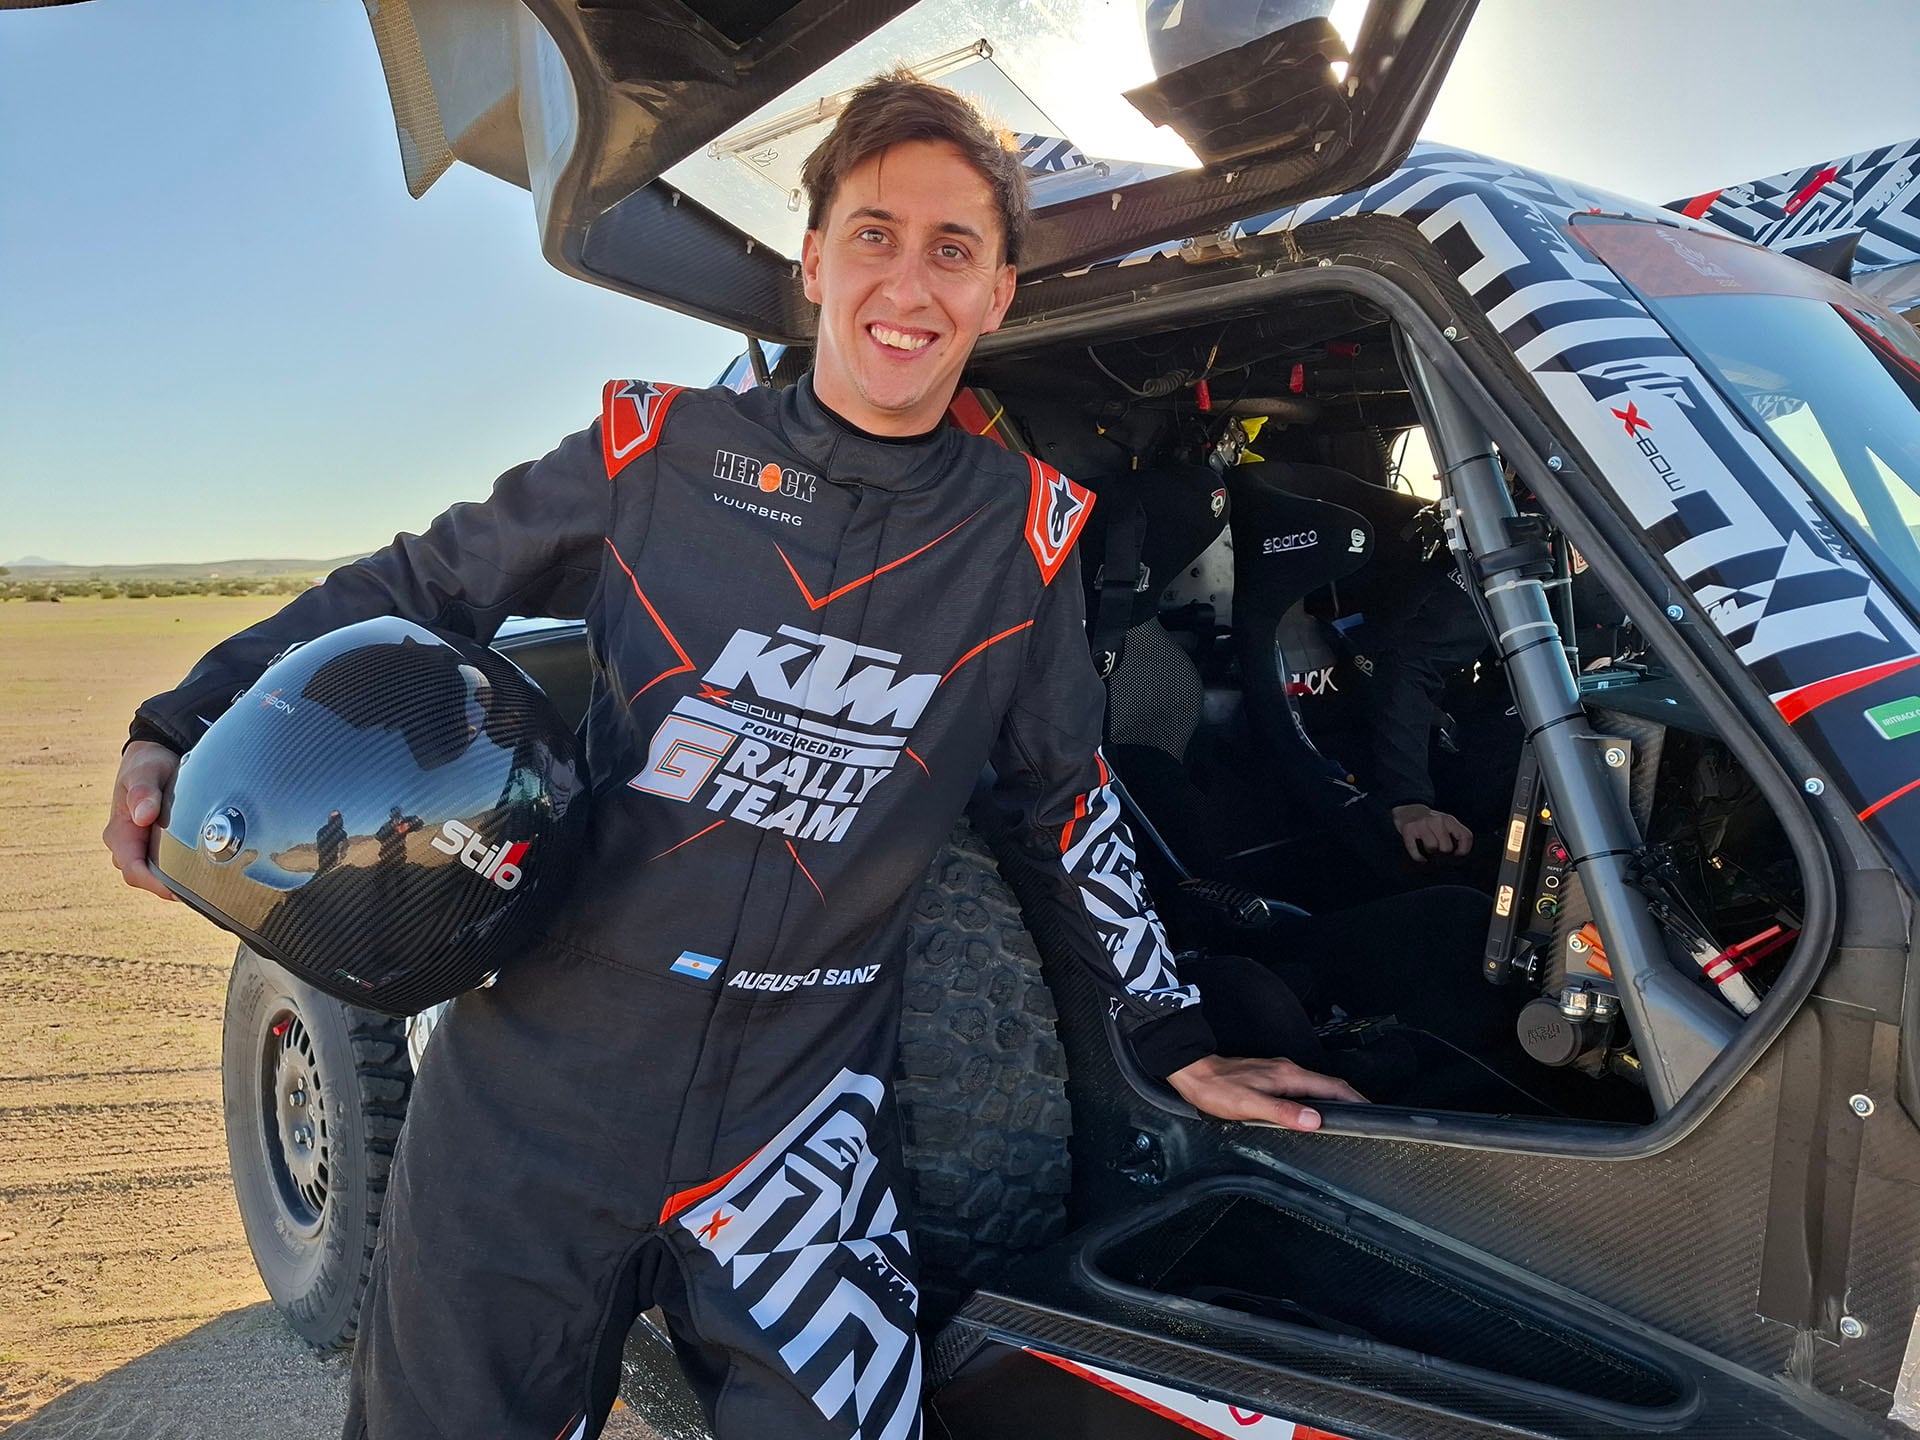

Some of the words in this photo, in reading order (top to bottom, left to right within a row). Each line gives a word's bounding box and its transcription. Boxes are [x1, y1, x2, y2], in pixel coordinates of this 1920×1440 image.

[713, 449, 817, 503] HEROCK
[713, 493, 803, 526] VUURBERG
[1262, 530, 1319, 554] sparco
[701, 624, 942, 729] KTM
[740, 721, 832, 757] POWERED
[828, 746, 853, 760] BY
[722, 737, 893, 804] RALLY
[706, 774, 859, 843] TEAM
[430, 819, 523, 891] Stilo
[727, 968, 821, 992] AUGUSO
[822, 963, 882, 987] SANZ
